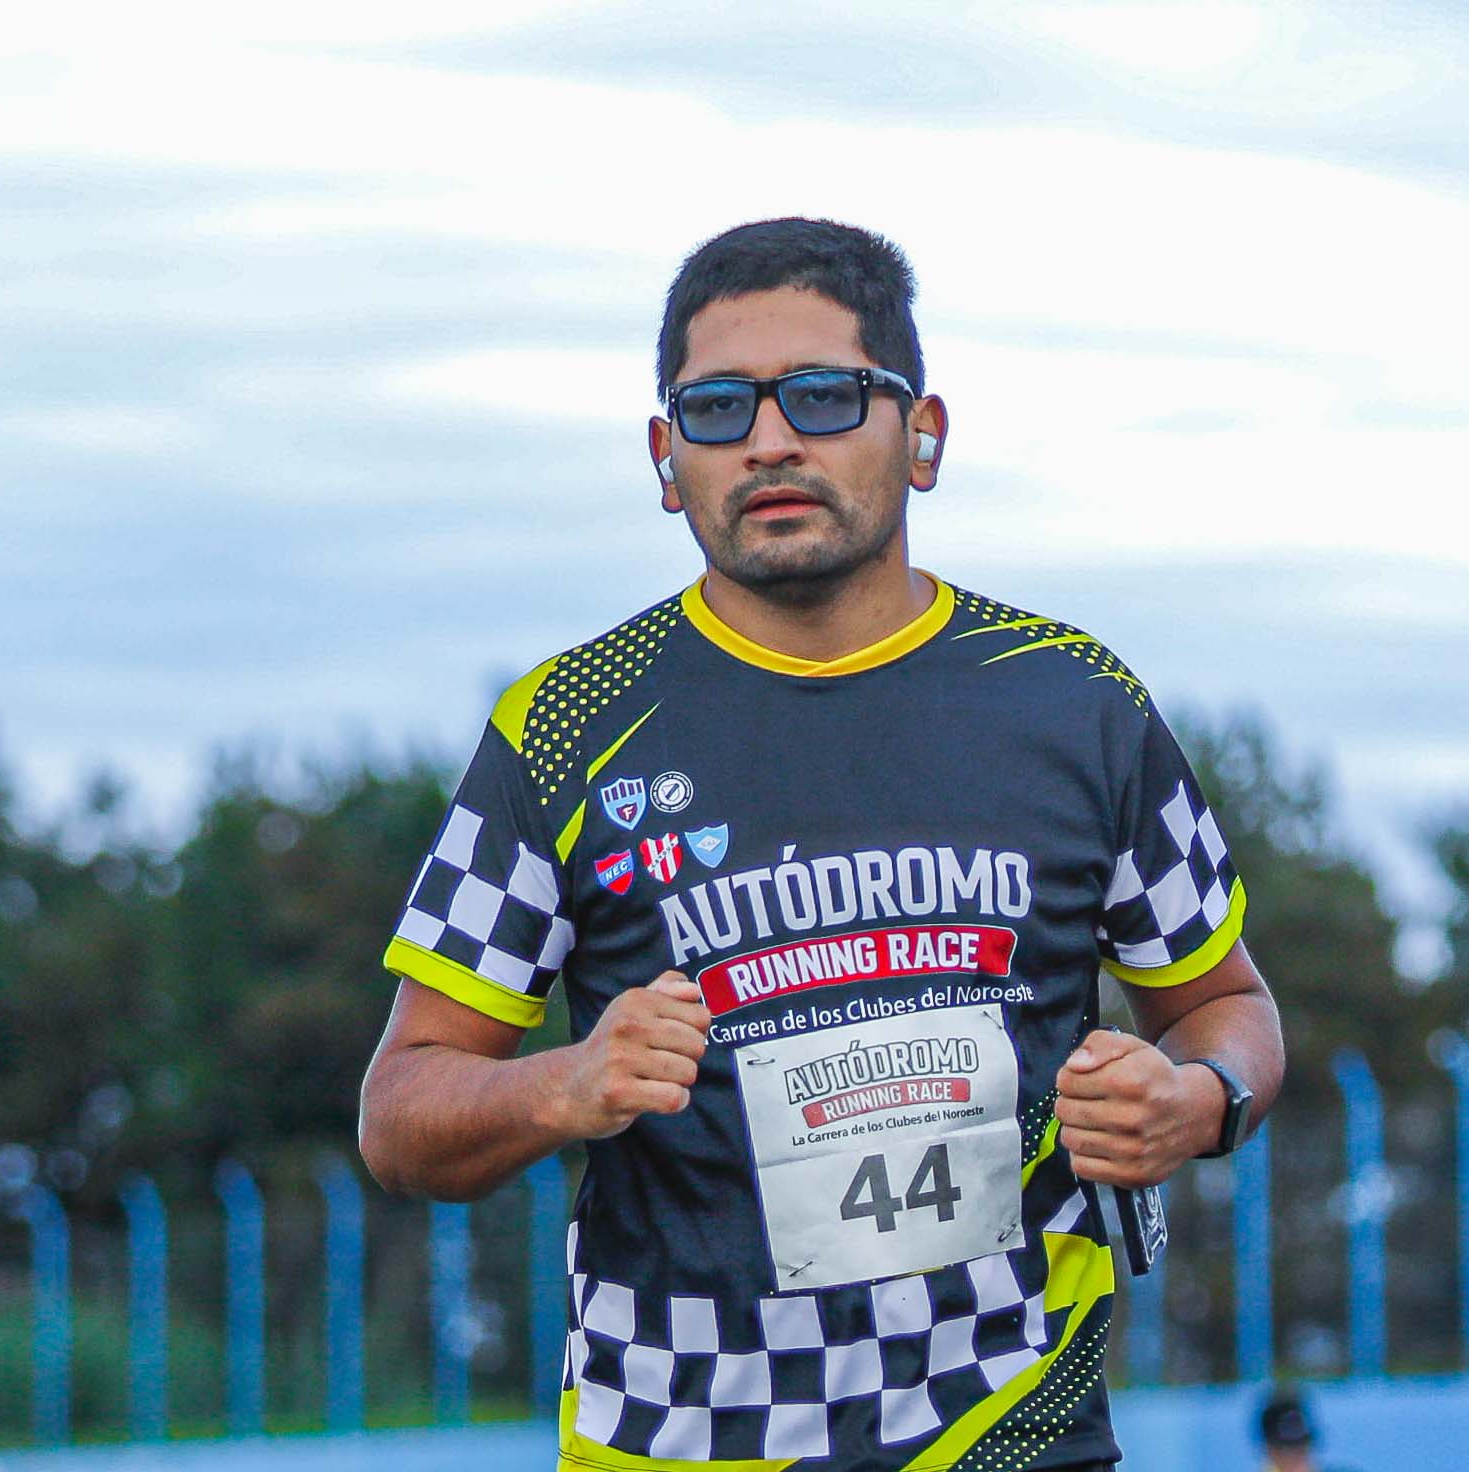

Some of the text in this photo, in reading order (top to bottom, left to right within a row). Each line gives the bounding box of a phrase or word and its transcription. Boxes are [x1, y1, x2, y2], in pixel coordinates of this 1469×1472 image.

[659, 844, 1031, 966] AUTÓDROMO
[727, 932, 980, 1001] RUNNING RACE
[710, 983, 1035, 1043] Carrera de los Clubes del Noroeste
[784, 1039, 979, 1104] AUTÓDROMO
[821, 1081, 952, 1121] RUNNING RACE
[792, 1106, 985, 1146] La Carrera de los Clubes del Noroeste
[839, 1143, 962, 1234] 44
